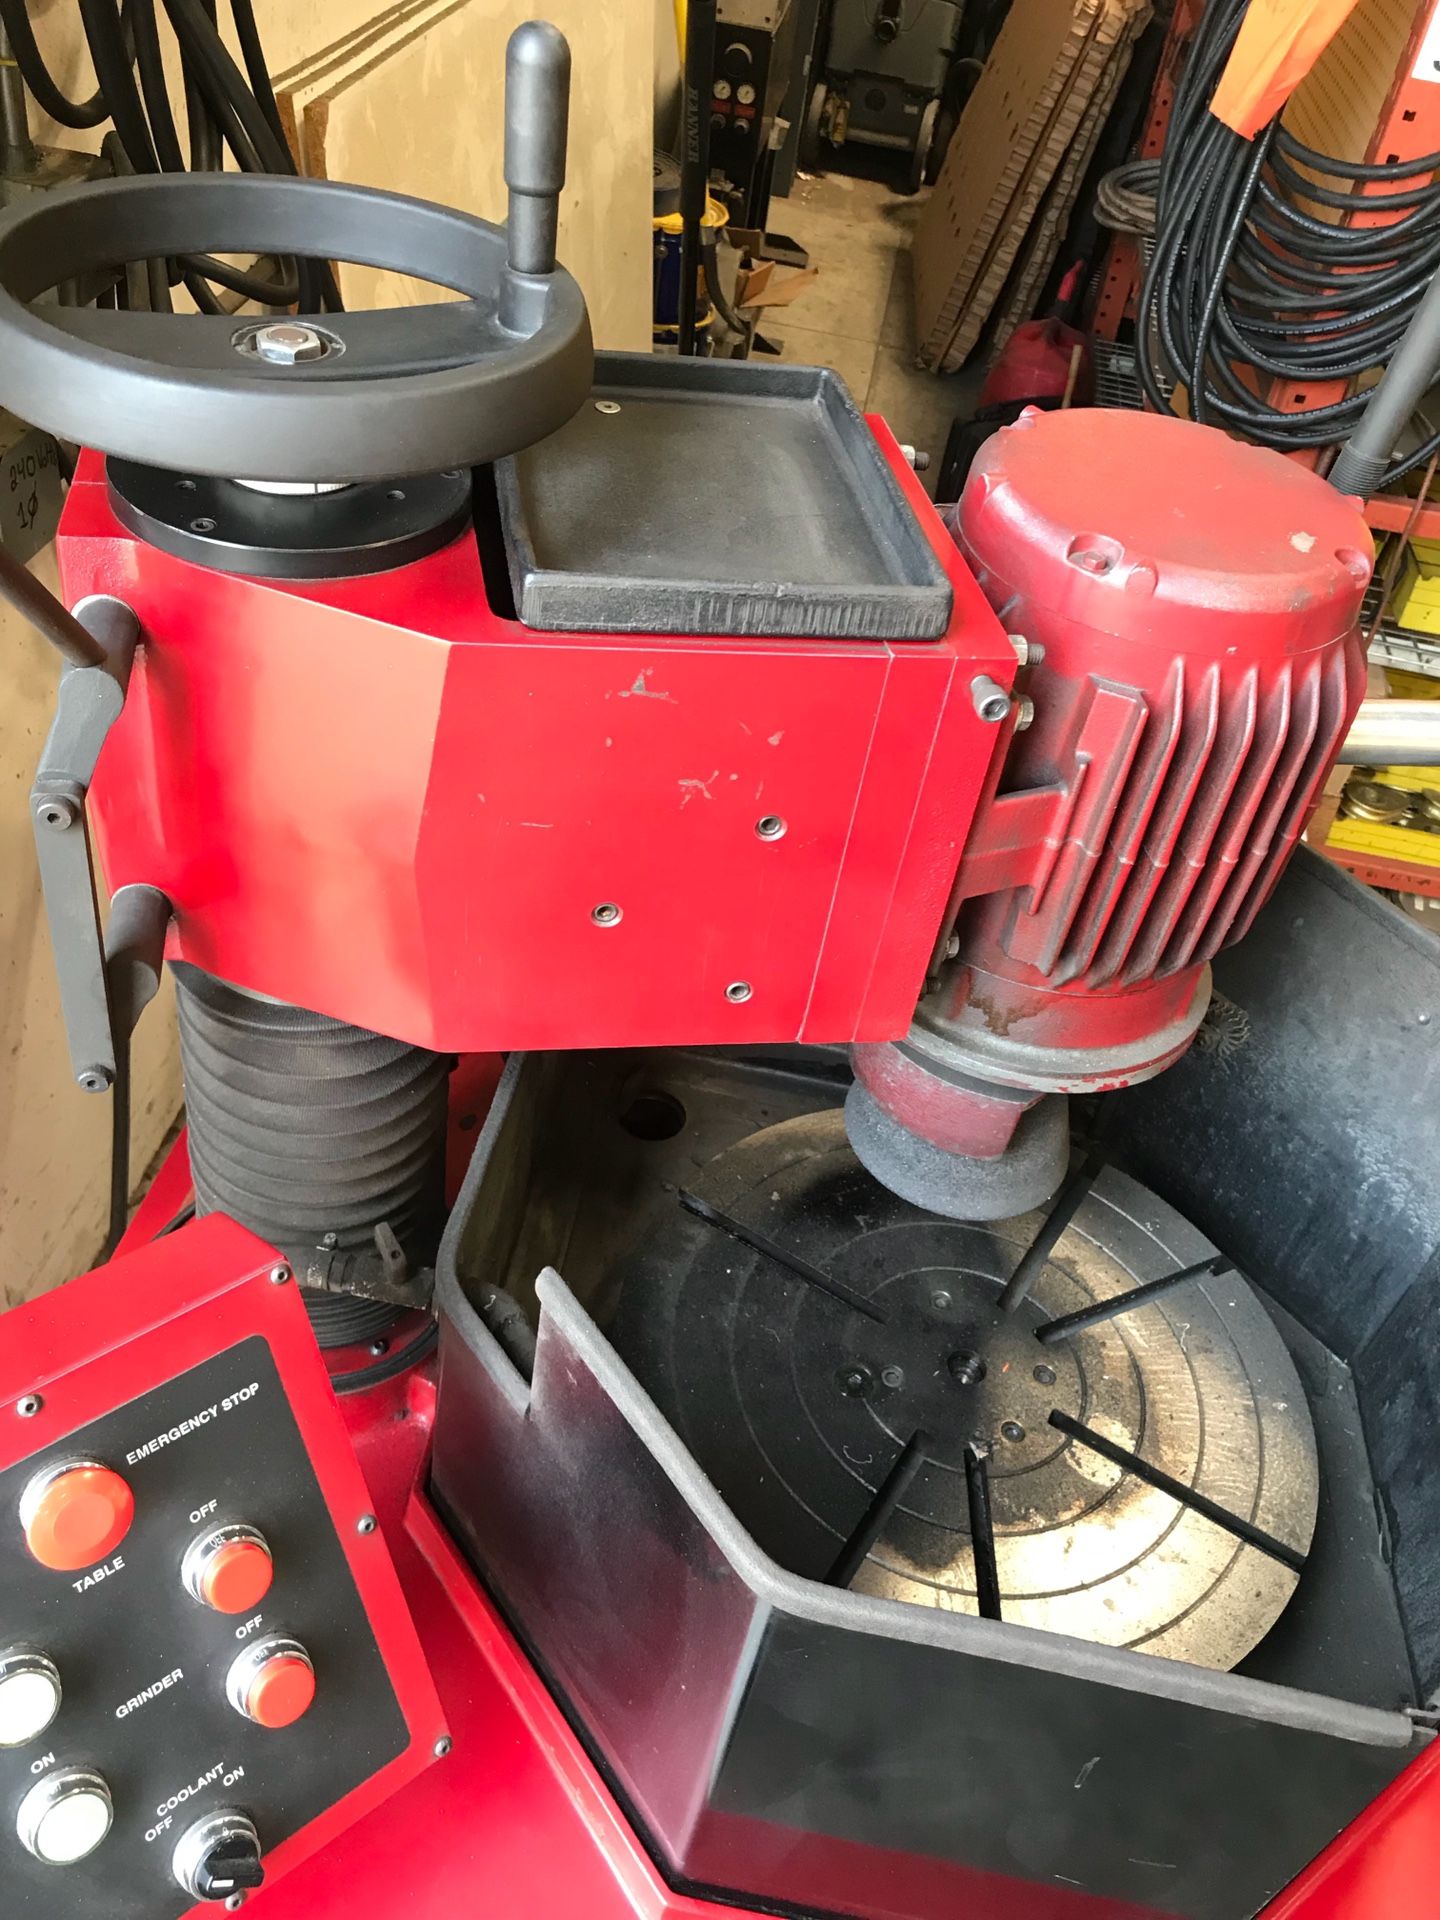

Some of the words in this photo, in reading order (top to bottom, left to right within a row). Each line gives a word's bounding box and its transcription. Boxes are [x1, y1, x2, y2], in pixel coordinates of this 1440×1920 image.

[9, 455, 36, 492] 240
[126, 1404, 218, 1465] EMERGENCY
[221, 1382, 259, 1412] STOP
[189, 1499, 218, 1524] OFF
[72, 1555, 126, 1593] TABLE
[235, 1614, 263, 1639] OFF
[115, 1668, 184, 1718] GRINDER
[30, 1752, 56, 1774] ON
[144, 1815, 173, 1842] OFF
[223, 1765, 245, 1787] ON
[156, 1762, 224, 1816] COOLANT
